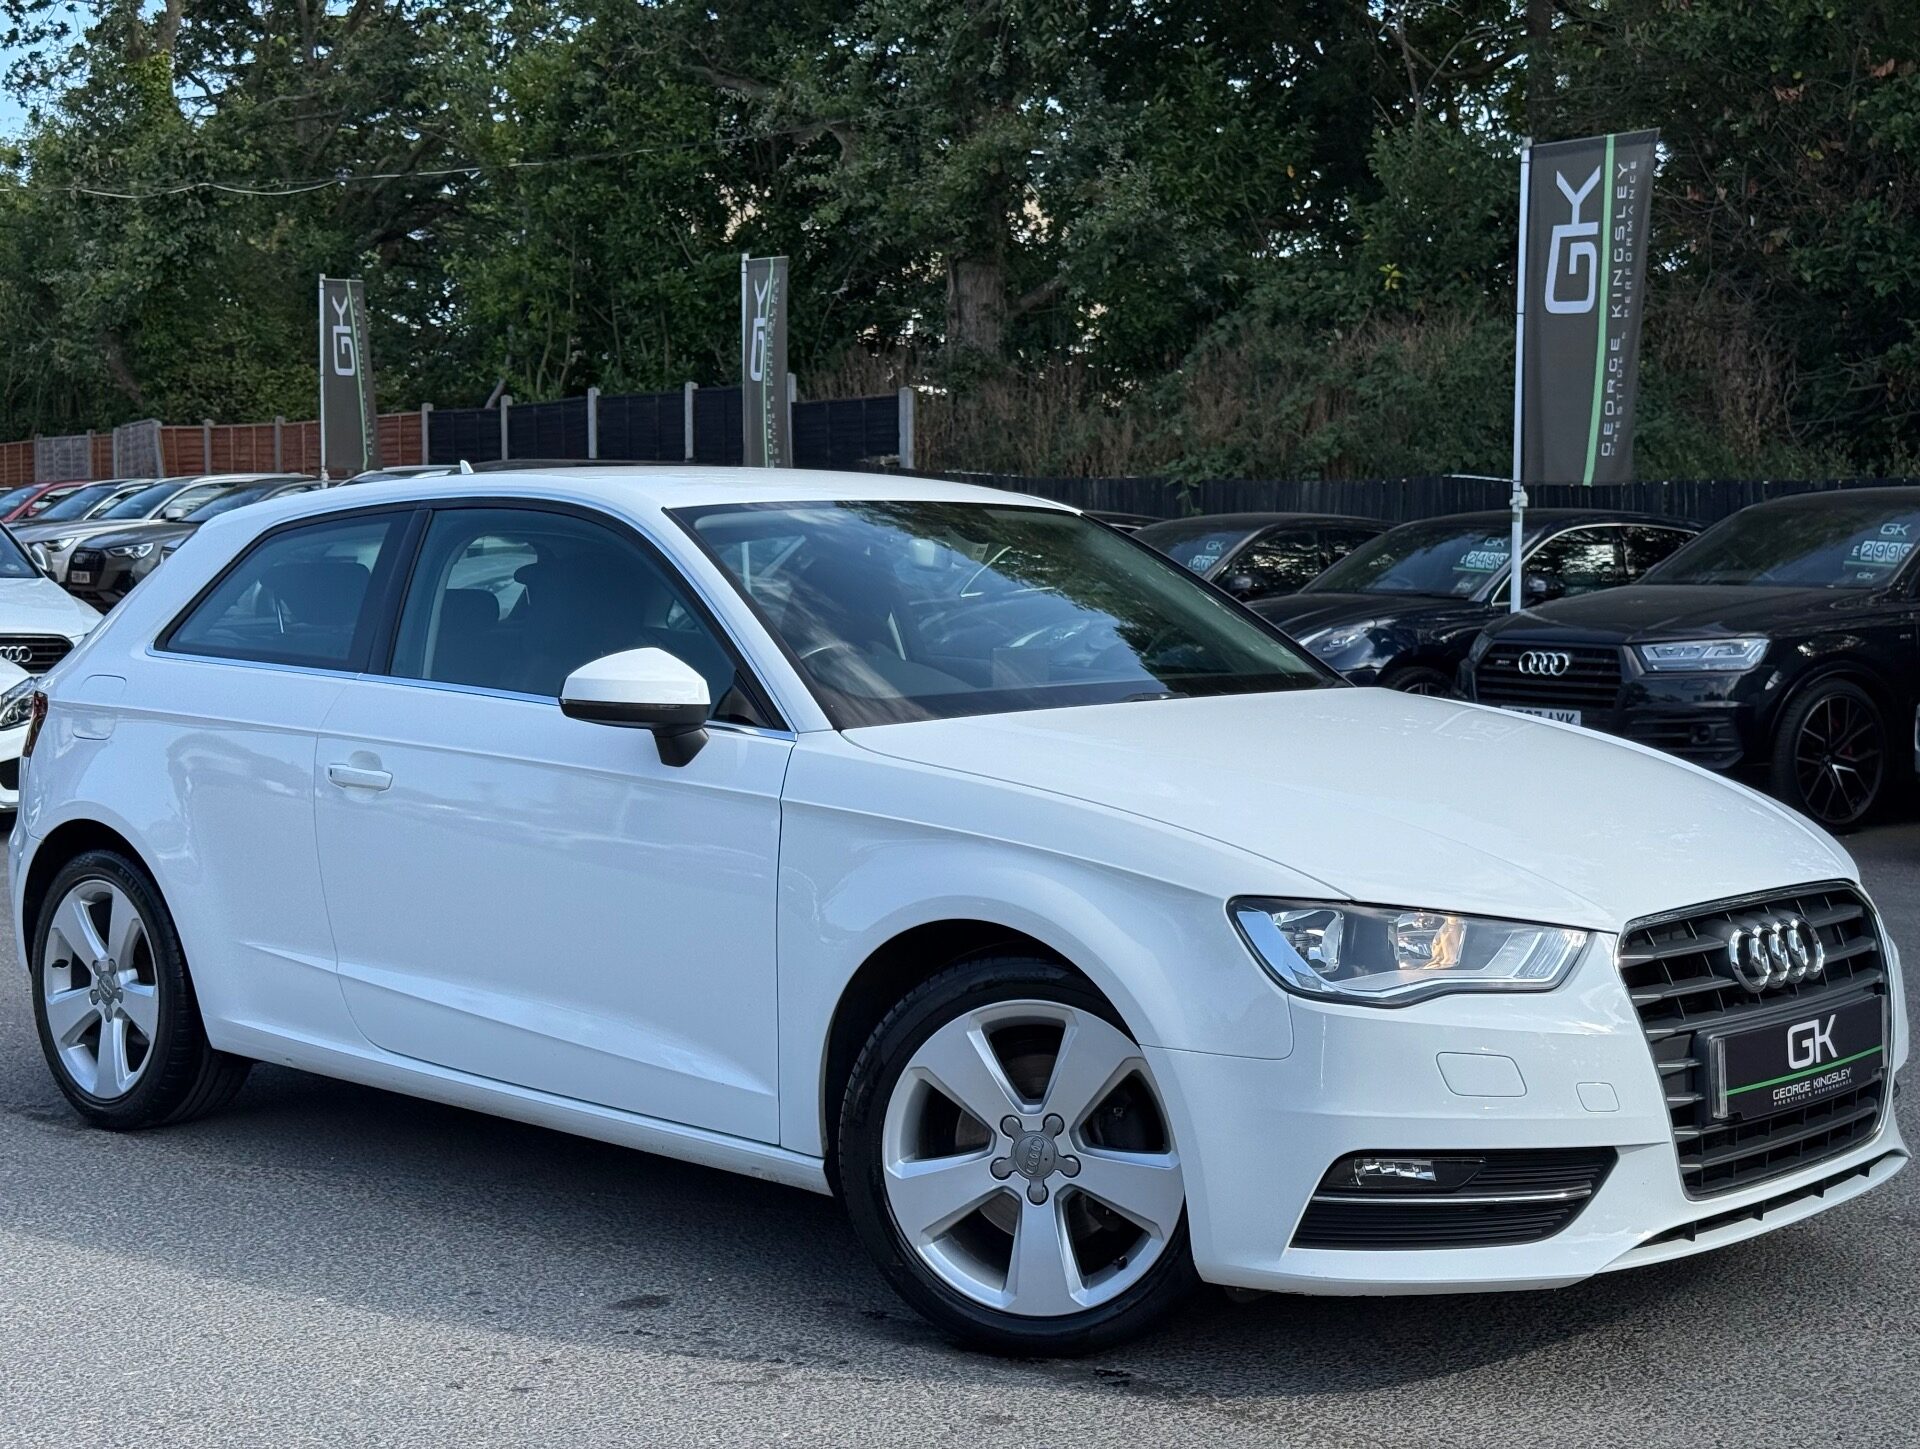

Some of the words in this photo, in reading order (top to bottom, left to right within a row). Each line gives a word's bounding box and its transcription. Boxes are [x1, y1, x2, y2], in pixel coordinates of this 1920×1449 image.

[1545, 164, 1602, 314] GK
[332, 296, 356, 376] GK
[750, 279, 768, 382] GK
[1601, 338, 1621, 456] GEORGE
[1611, 163, 1629, 318] KINGSLEY
[1880, 523, 1911, 536] GK
[1787, 1014, 1838, 1069] GK
[1772, 1081, 1811, 1100] GEORGE
[1813, 1067, 1852, 1089] KINGSLEY
